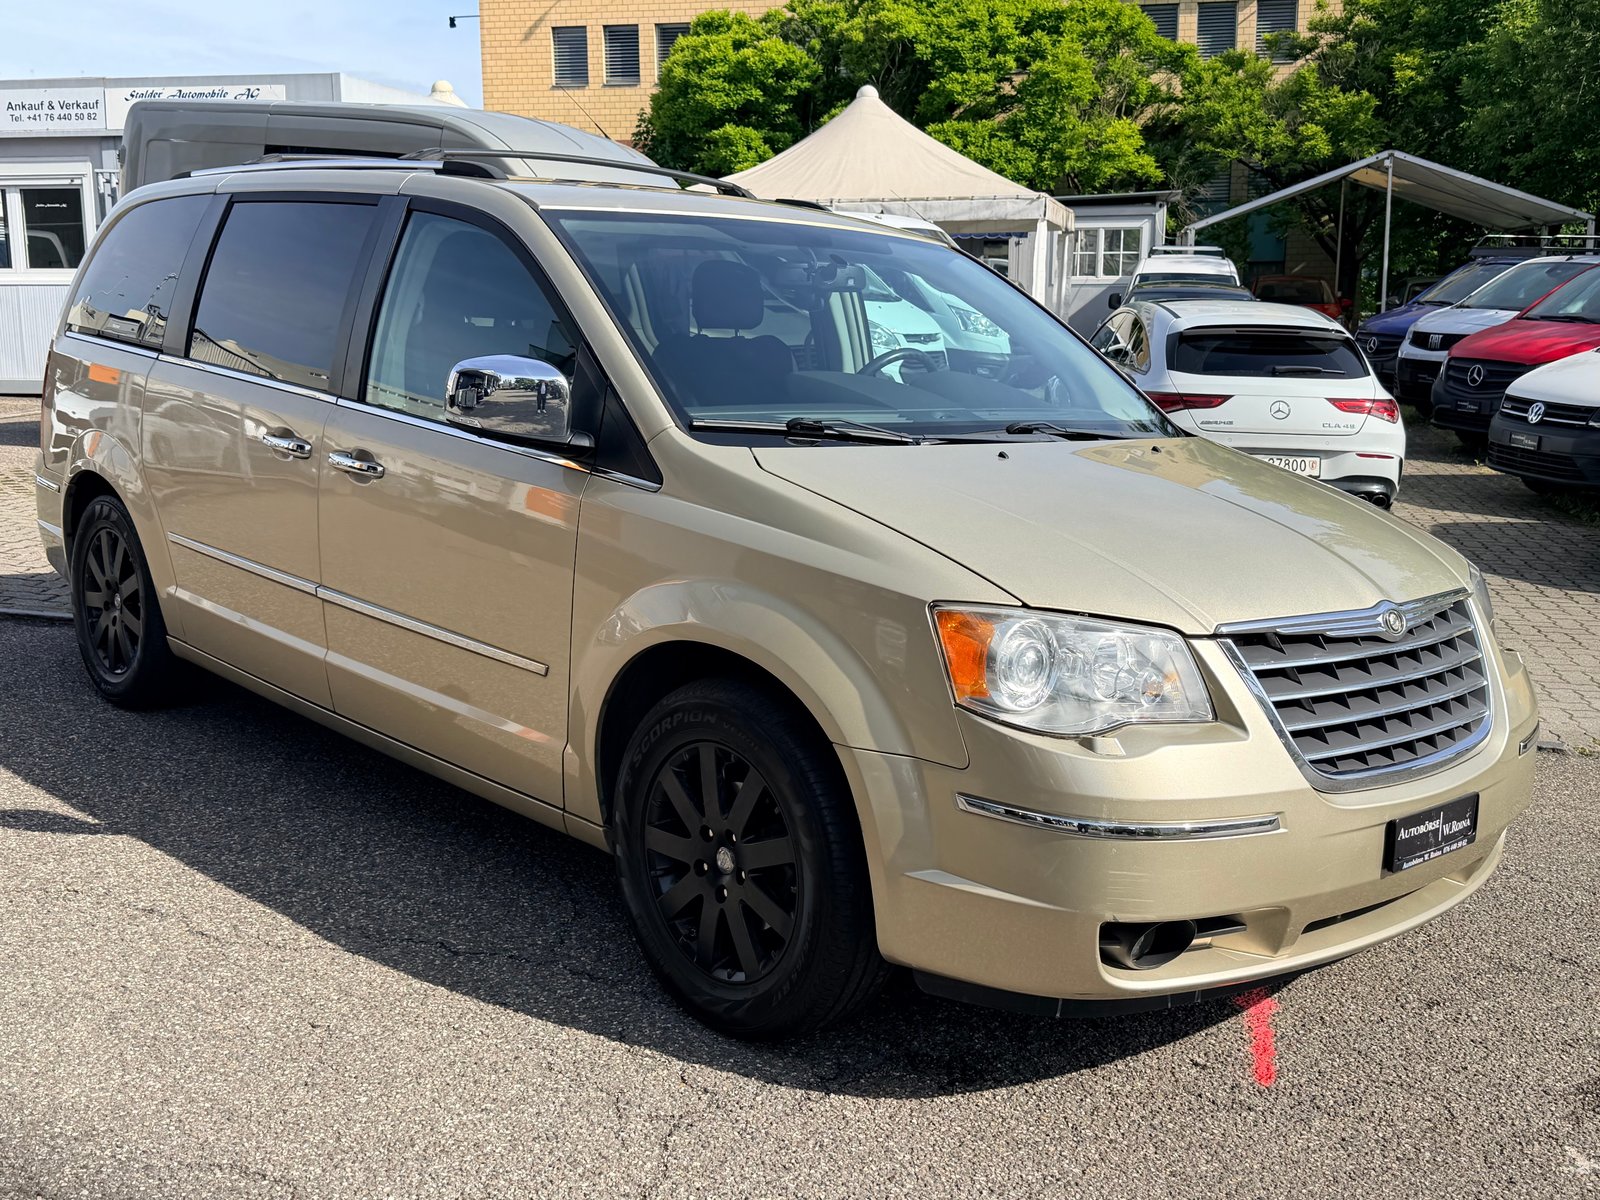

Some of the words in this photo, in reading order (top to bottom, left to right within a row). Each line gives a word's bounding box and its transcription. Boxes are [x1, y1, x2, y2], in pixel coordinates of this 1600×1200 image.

[124, 89, 163, 102] Stalder
[167, 88, 229, 100] Automobile
[234, 88, 260, 100] AG
[6, 101, 44, 111] Ankauf
[47, 100, 55, 111] &
[58, 99, 100, 110] Verkauf
[10, 113, 24, 122] Tel.
[27, 113, 41, 121] +41
[44, 113, 55, 121] 76
[57, 112, 72, 121] 440
[74, 112, 84, 121] 50
[86, 112, 97, 120] 82
[632, 711, 718, 768] SCORPION
